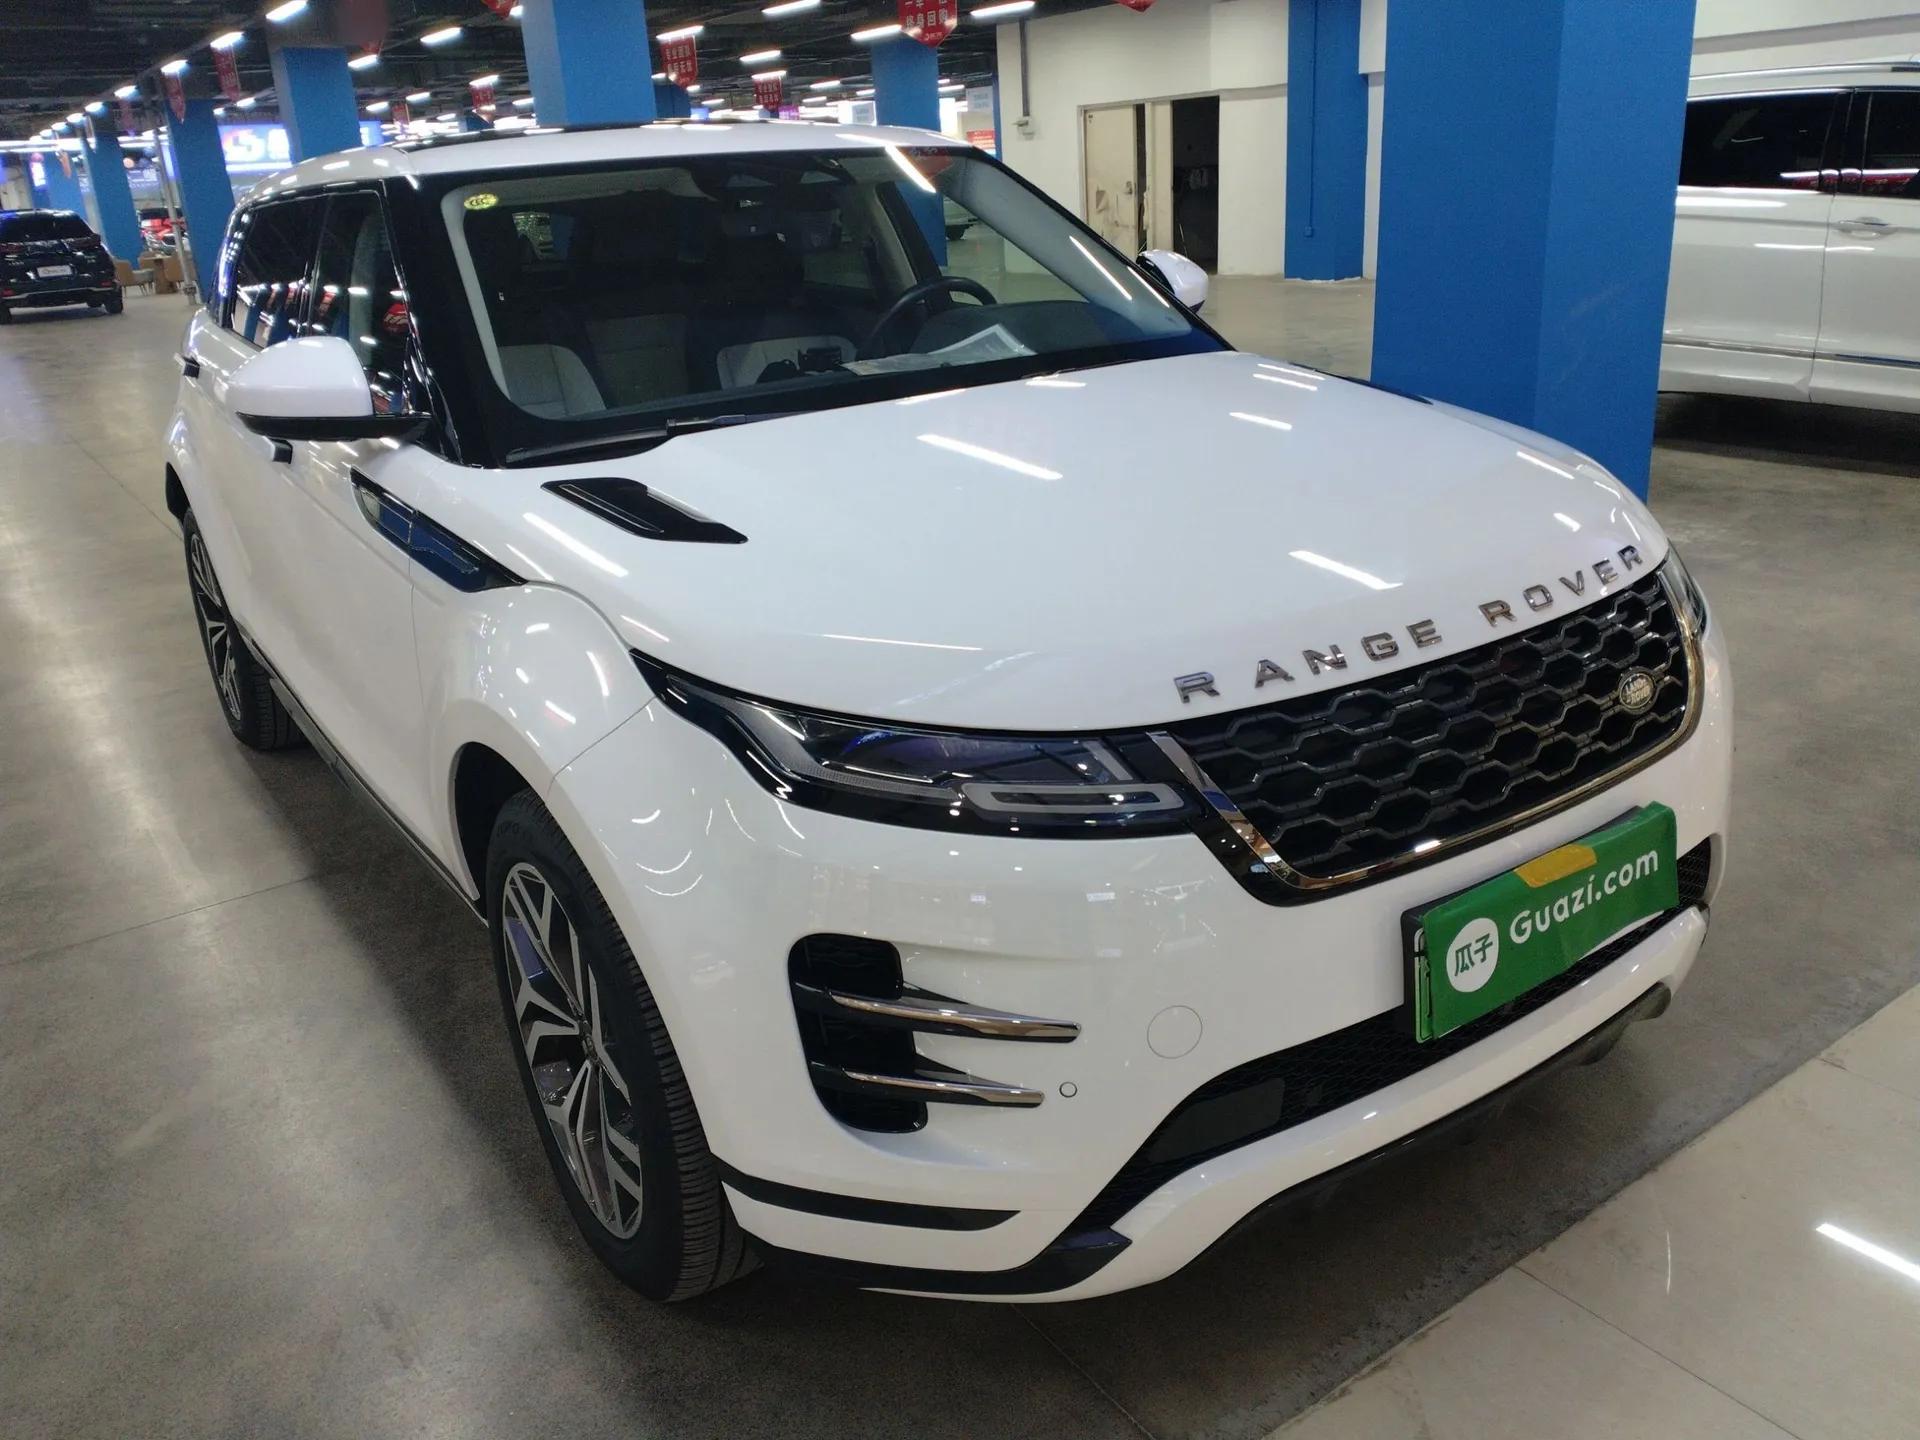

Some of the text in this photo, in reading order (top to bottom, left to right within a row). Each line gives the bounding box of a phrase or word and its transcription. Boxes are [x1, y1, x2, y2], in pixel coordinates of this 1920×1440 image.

[1173, 544, 1643, 704] RANGE ROVER
[1509, 849, 1659, 945] Guazi.com
[1454, 932, 1494, 977] 瓜子
